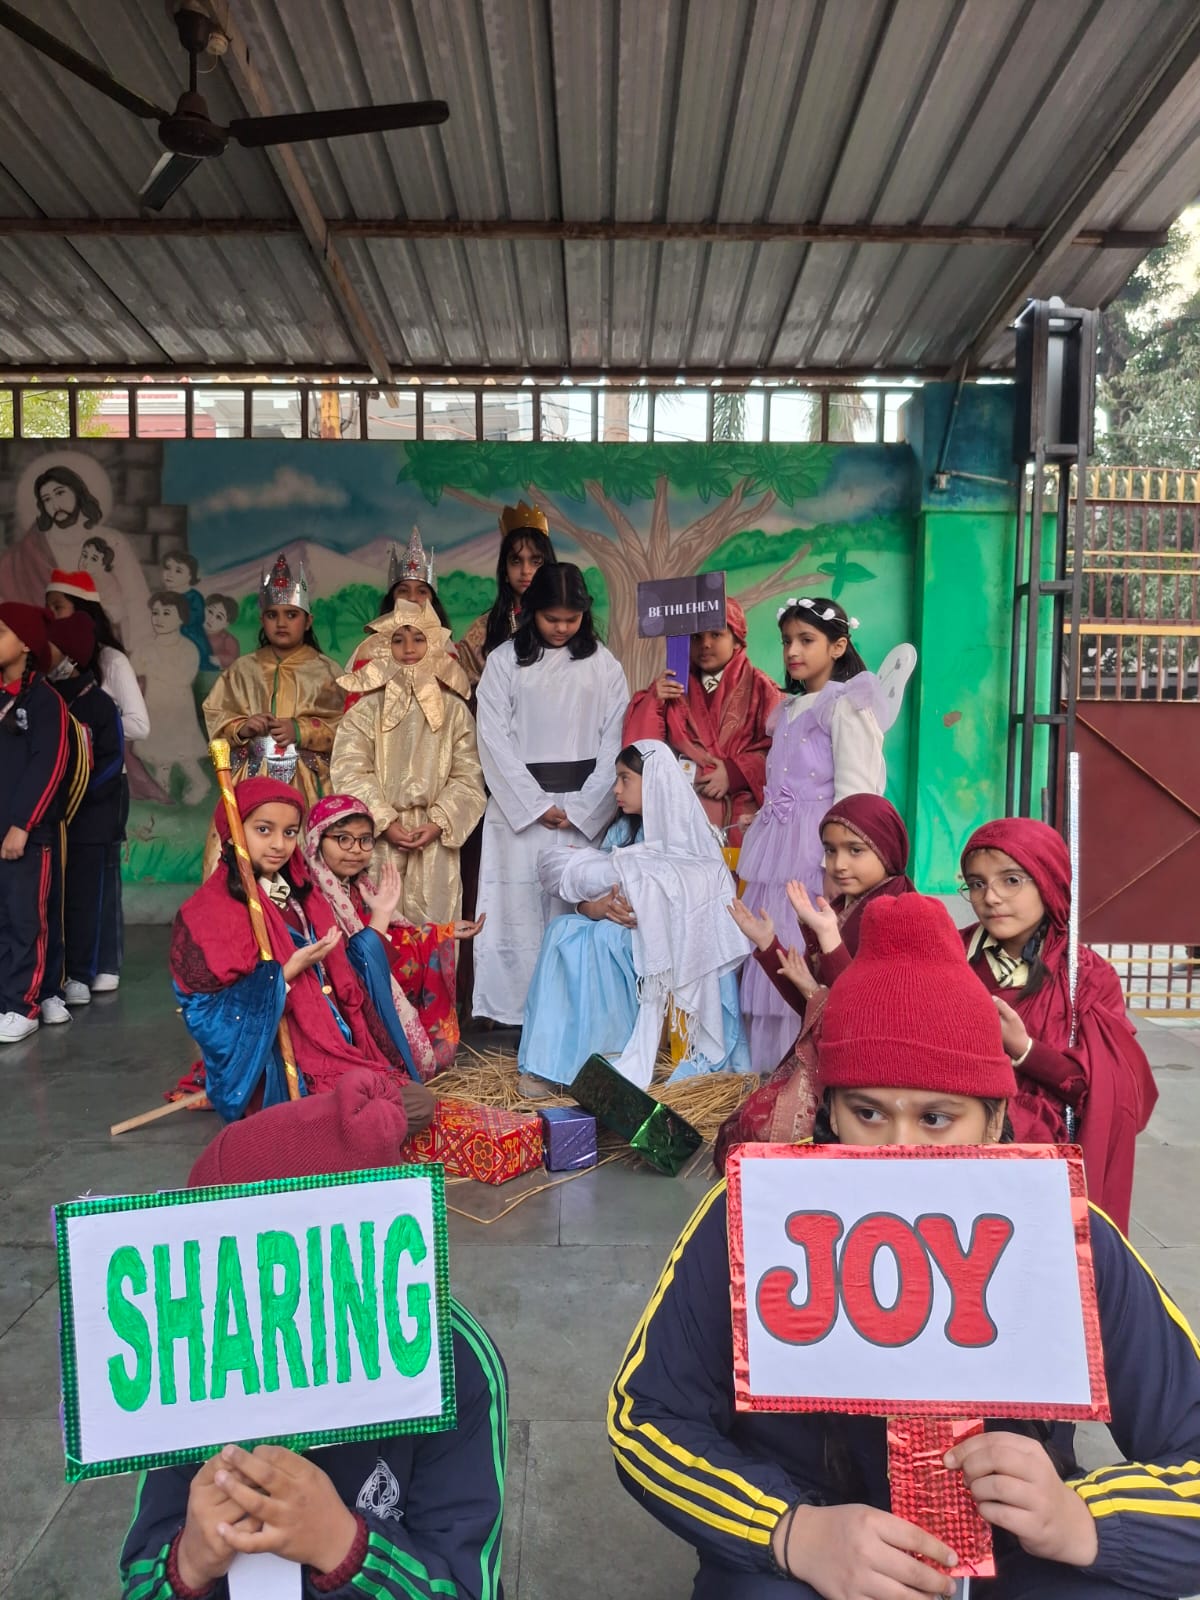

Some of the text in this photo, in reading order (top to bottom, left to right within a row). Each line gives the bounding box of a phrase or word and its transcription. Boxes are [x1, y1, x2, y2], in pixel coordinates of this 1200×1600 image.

[648, 600, 719, 618] BETHLEHEM
[107, 1213, 432, 1412] SHARING
[756, 1210, 1014, 1348] JOY
